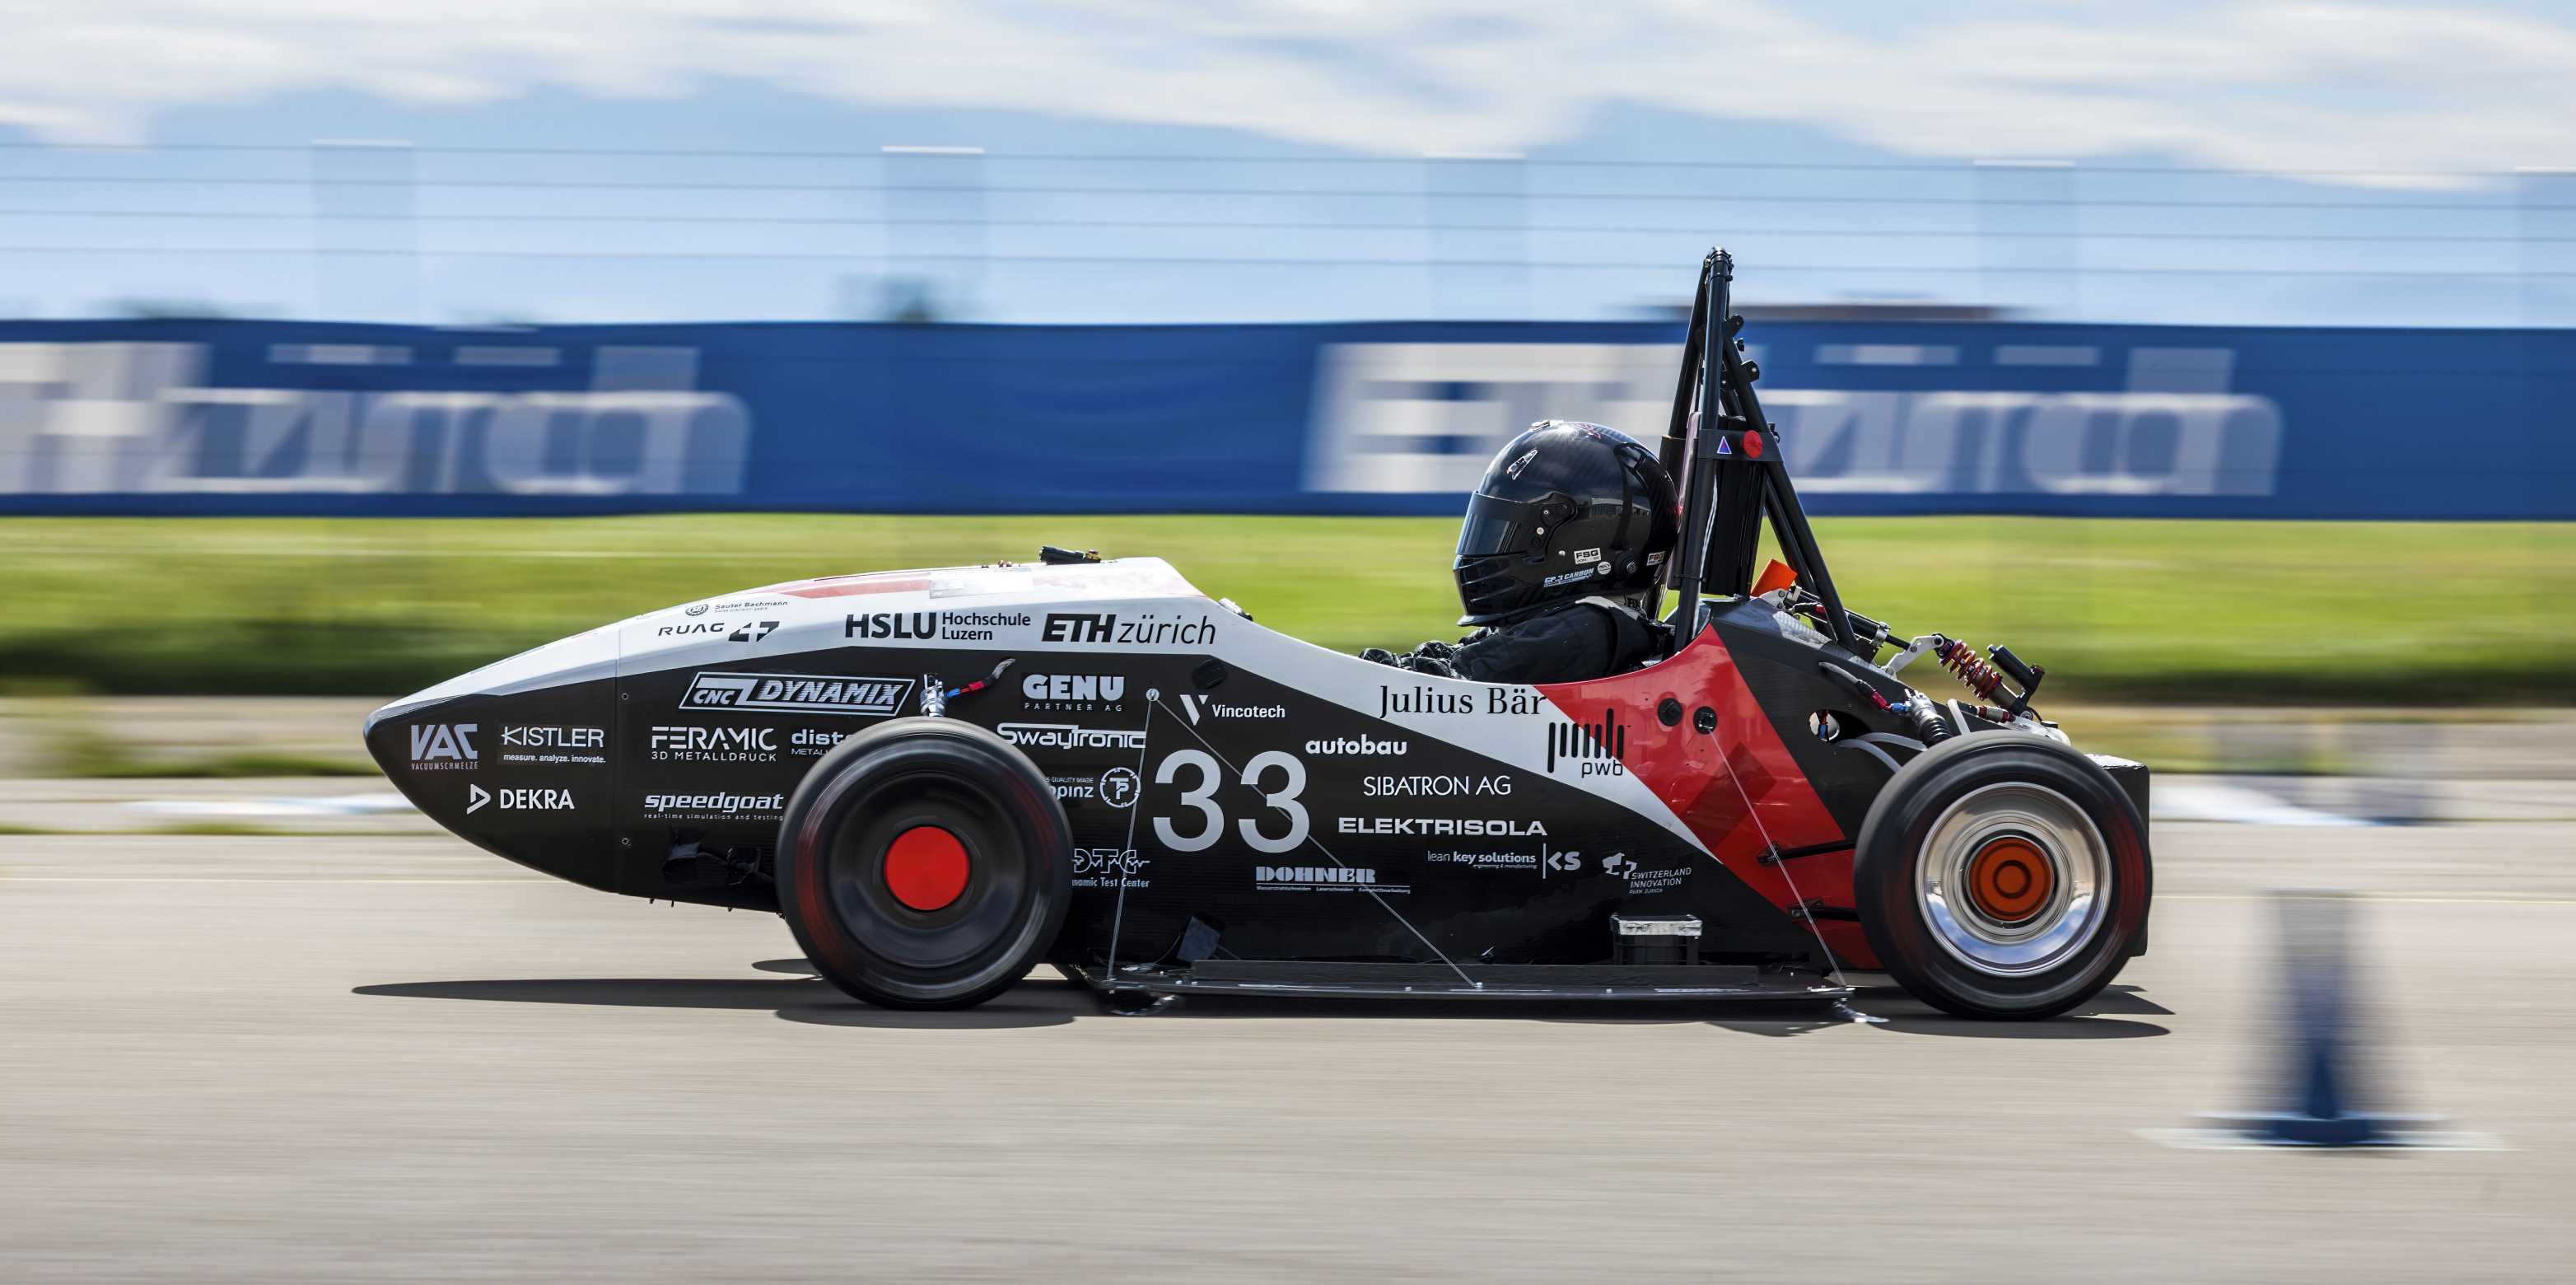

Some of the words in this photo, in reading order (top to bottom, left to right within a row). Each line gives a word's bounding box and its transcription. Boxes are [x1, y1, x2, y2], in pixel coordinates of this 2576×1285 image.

[1576, 549, 1598, 558] FSG
[1564, 568, 1594, 580] CARBON
[658, 623, 725, 637] RUAG
[844, 612, 937, 640] HSLU
[941, 612, 1031, 627] Hochschule
[941, 627, 993, 641] Luzern
[1041, 613, 1117, 642] ETH
[1118, 615, 1216, 644] zürich
[693, 690, 737, 705] CNC
[758, 680, 903, 705] DYNAMIX
[1022, 674, 1125, 701] GENU
[1024, 703, 1094, 711] PARTNER
[1211, 704, 1286, 718] Vincotech
[1379, 685, 1473, 719] Julius
[1486, 687, 1547, 715] Bär
[411, 723, 478, 761] VAC
[501, 726, 604, 748] KISTLER
[651, 726, 777, 750] FERAMIC
[1305, 734, 1407, 755] autobau
[411, 761, 478, 771] VACUUMSCHMELZE
[503, 754, 538, 762] measure.
[539, 754, 570, 764] analyze.
[571, 755, 607, 764] innovate.
[651, 751, 669, 760] 3D
[674, 751, 777, 762] METALLDRUCK
[1581, 759, 1624, 778] pwb
[1363, 776, 1469, 796] SIBATRON
[1475, 775, 1512, 796] AG
[500, 789, 575, 810] DEKRA
[644, 792, 784, 813] speedgoat
[1153, 749, 1310, 853] 33
[1338, 817, 1548, 836] ELEKTRISOLA
[1427, 850, 1450, 862] lean
[1453, 851, 1477, 865] key
[1478, 852, 1537, 863] solutions
[1100, 877, 1118, 887] Test
[1121, 877, 1150, 888] Center
[1255, 867, 1376, 884] DOHNER
[1631, 867, 1692, 880] SWITZERLAND
[1631, 877, 1682, 888] INNOVATION
